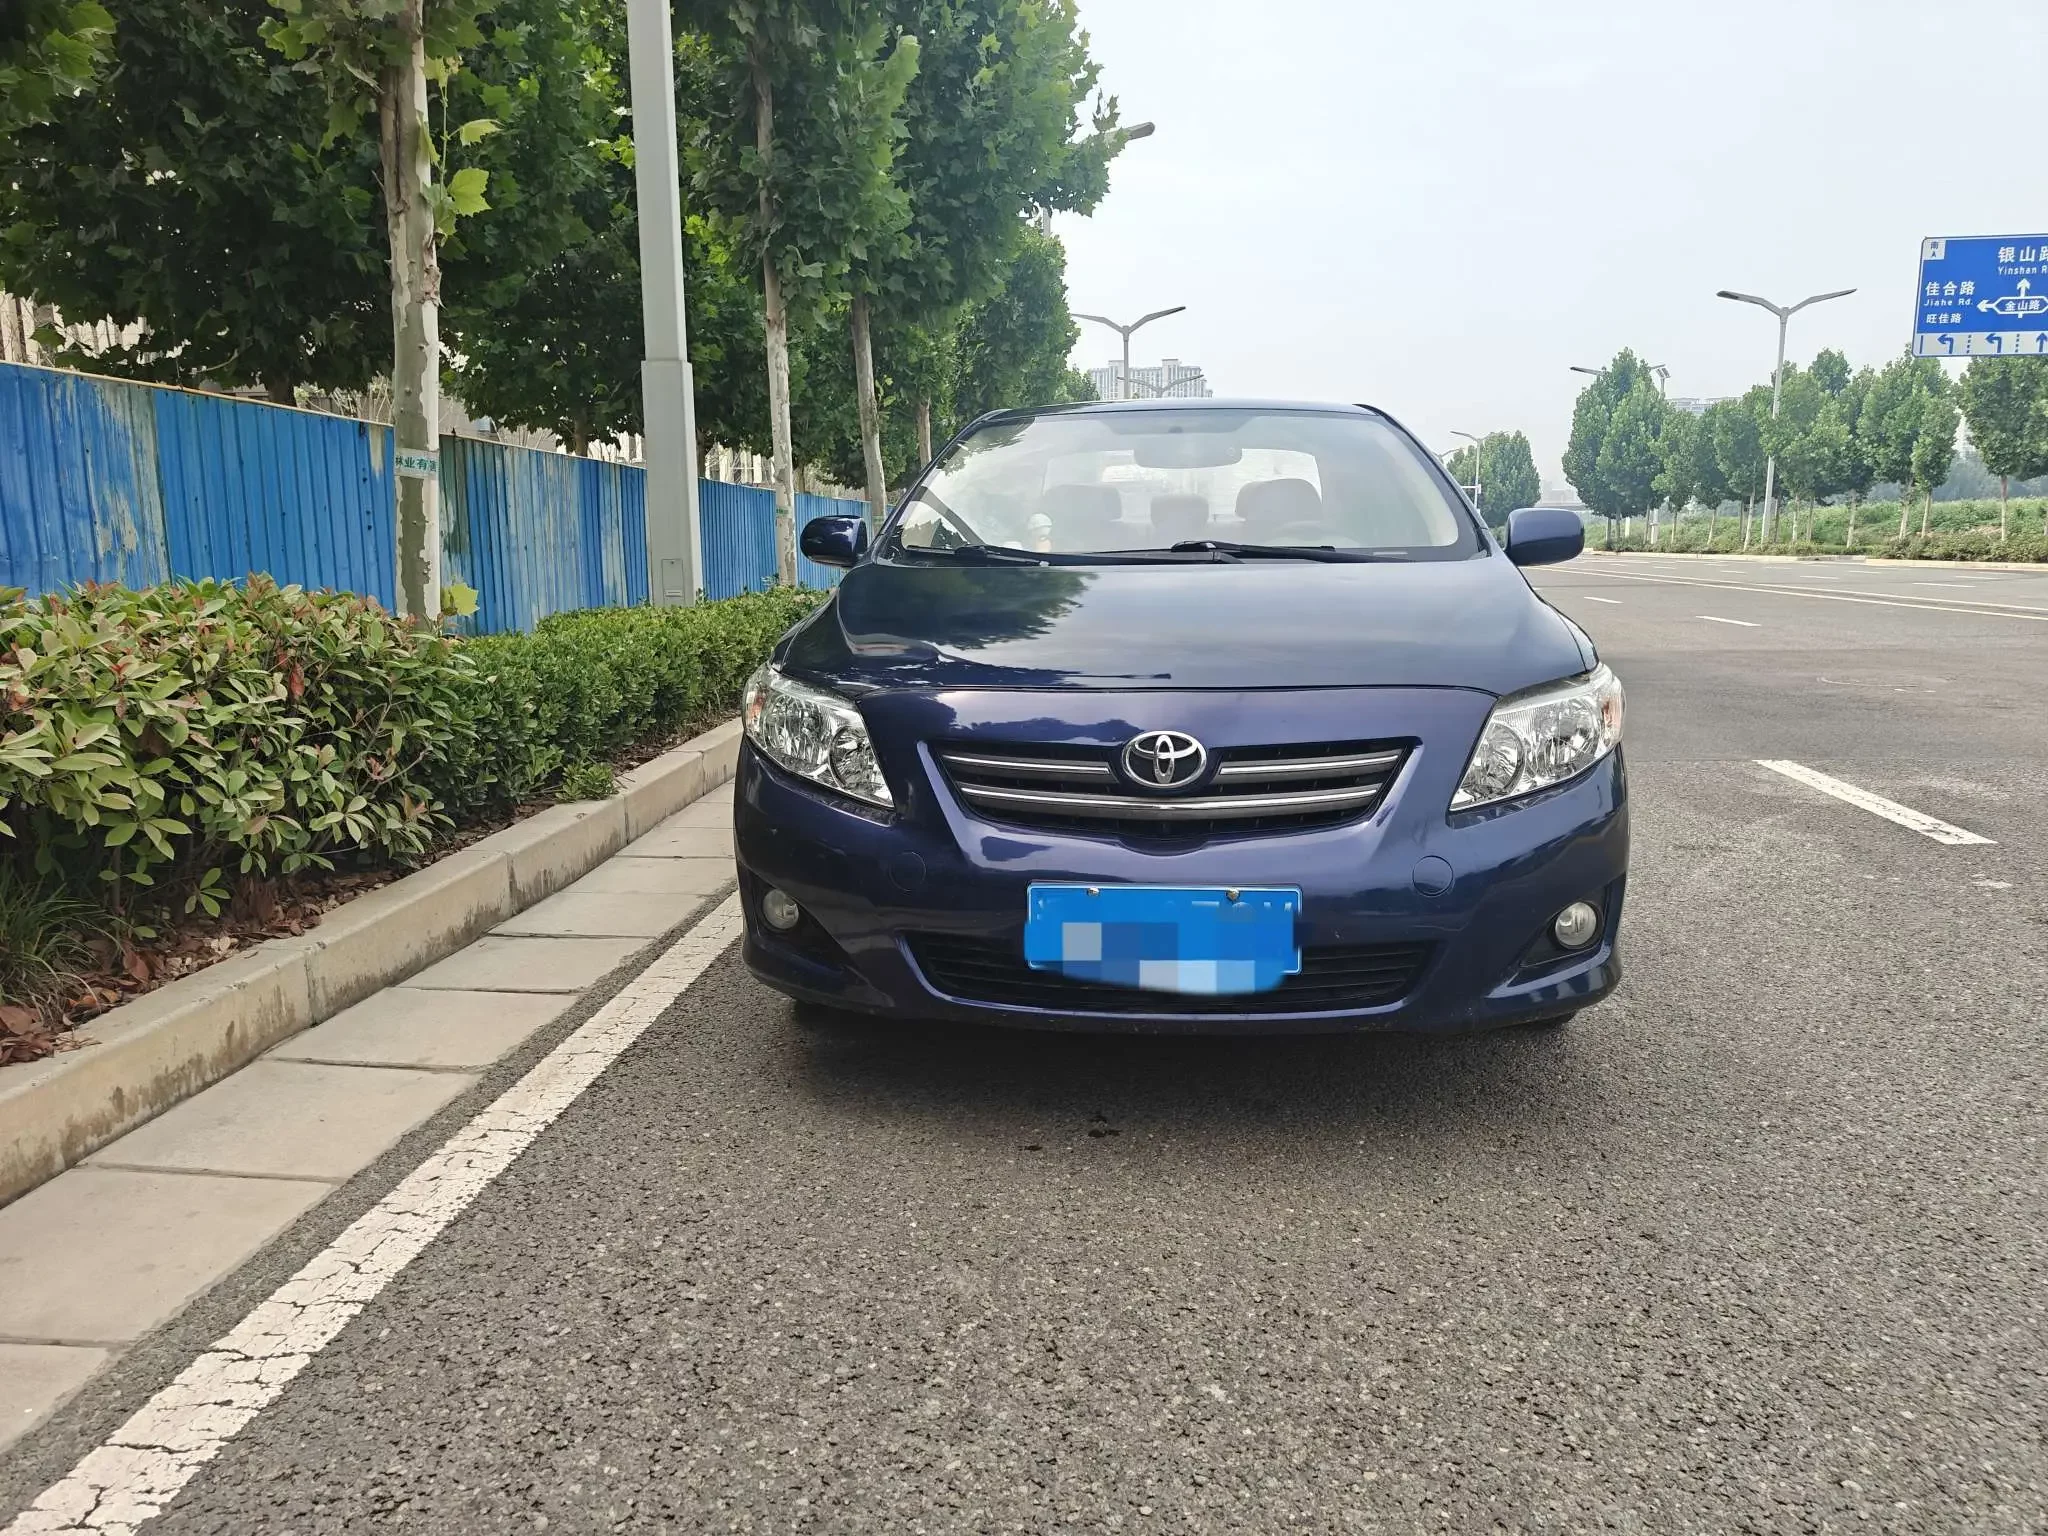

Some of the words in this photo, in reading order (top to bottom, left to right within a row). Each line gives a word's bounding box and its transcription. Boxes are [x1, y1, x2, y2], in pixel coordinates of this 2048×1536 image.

[1998, 266, 2037, 275] Yinshan
[1925, 281, 1975, 296] 佳合路
[2005, 300, 2041, 311] 金山路
[1926, 313, 1962, 324] 旺佳路
